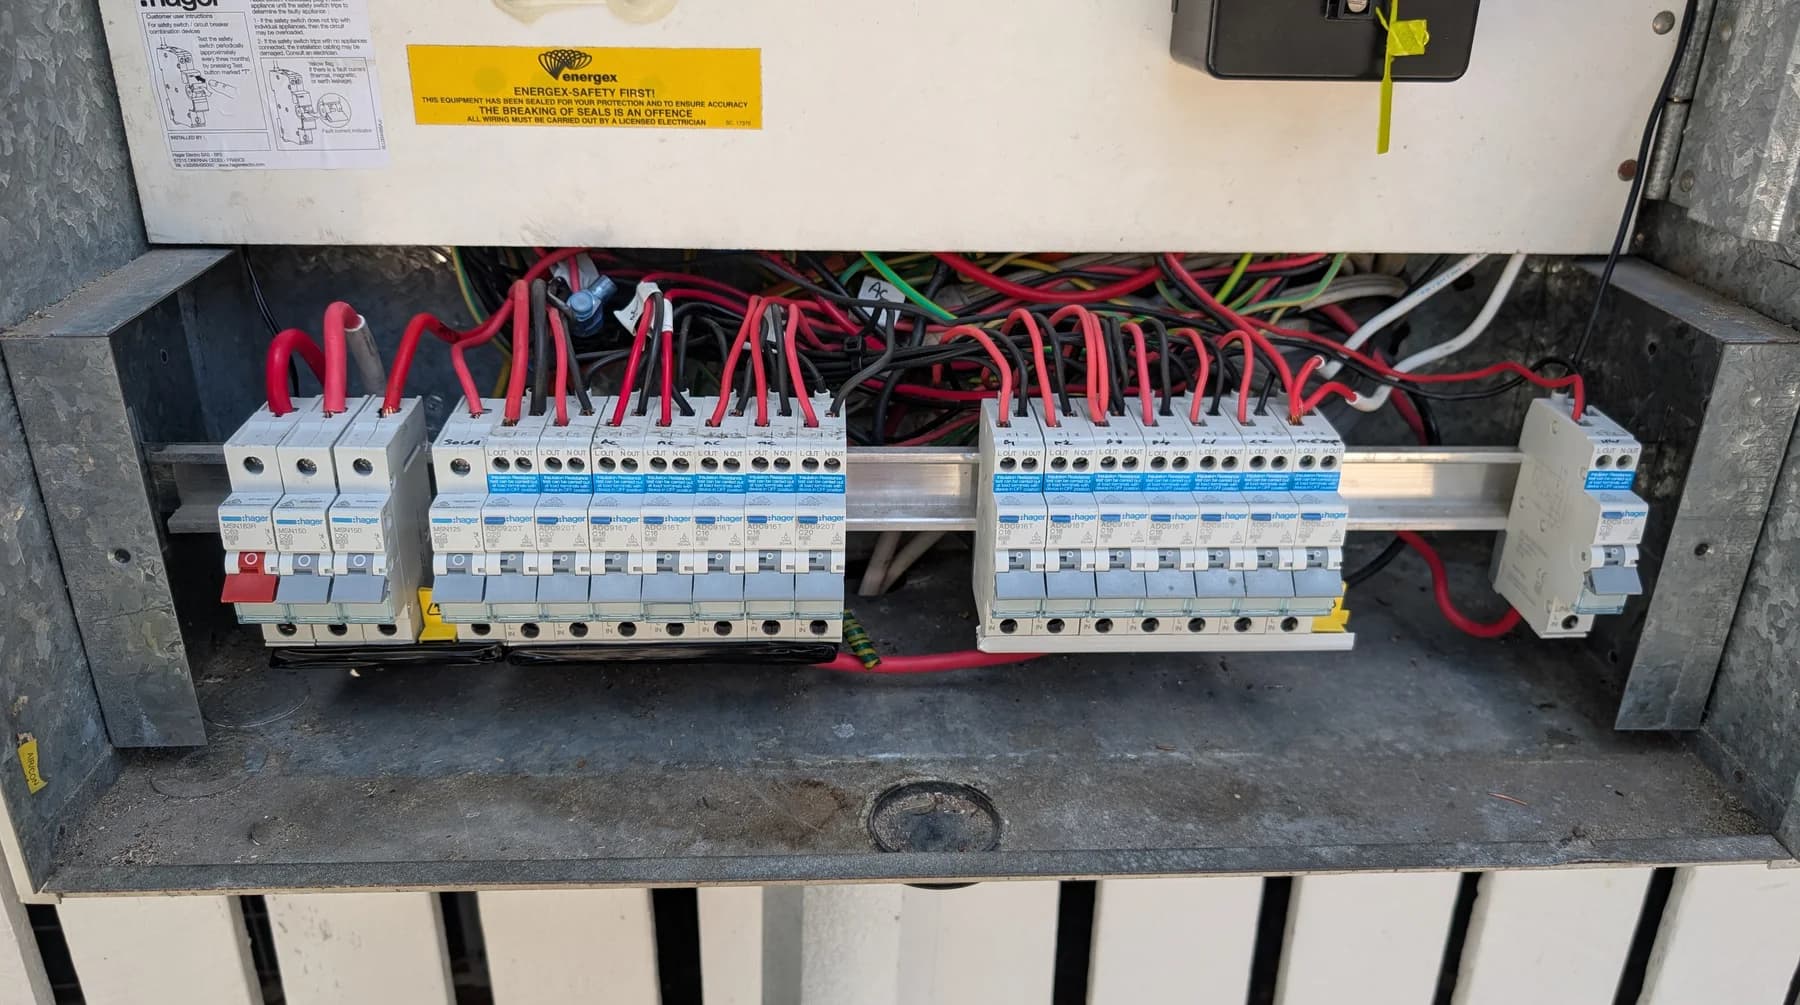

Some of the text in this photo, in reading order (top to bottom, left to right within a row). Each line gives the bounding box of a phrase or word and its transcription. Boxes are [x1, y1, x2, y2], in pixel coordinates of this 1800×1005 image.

[562, 73, 618, 85] energex
[514, 87, 655, 98] ENERGEX-SAFETY FIRST!
[440, 96, 483, 104] EQUIPMENT
[479, 106, 693, 118] THE BREAKING OF SEALS IS AN OFFENCE
